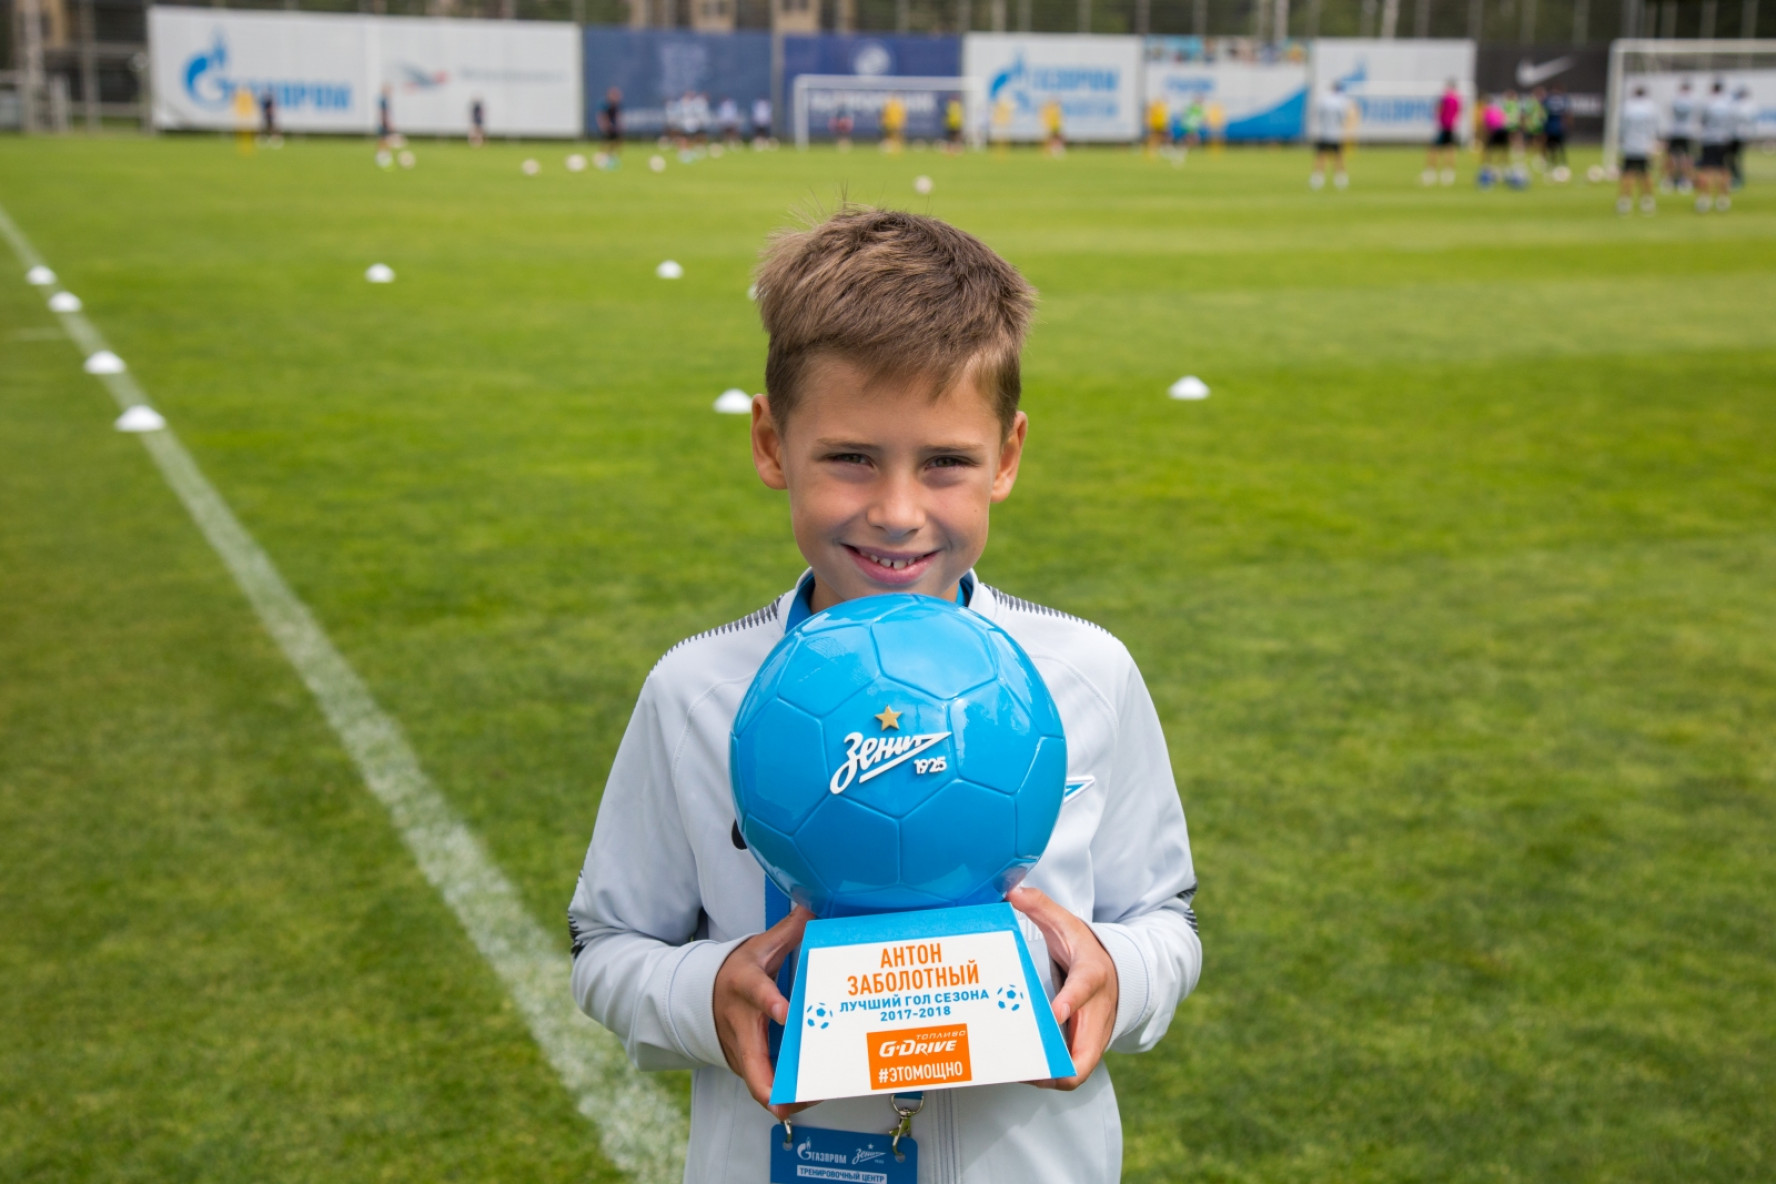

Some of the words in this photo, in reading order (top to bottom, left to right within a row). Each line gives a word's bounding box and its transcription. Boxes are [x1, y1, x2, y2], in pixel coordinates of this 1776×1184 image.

[914, 756, 947, 774] 1925
[880, 943, 942, 968] АНТОН
[847, 960, 979, 996] ЗАБОЛОТНЫЙ
[840, 994, 901, 1012] ЛУЧШИЙ
[905, 994, 931, 1007] ГОЛ
[934, 989, 989, 1004] СЕЗОНА
[880, 1006, 951, 1022] 2017-2018
[916, 1030, 966, 1041] ТОПЛИВО
[878, 1061, 963, 1083] #ЭТОМОЩНО
[811, 1152, 847, 1165] ГАЗПРОМ
[800, 1167, 860, 1180] ТРЕНИРОВОЧНЫЙ
[862, 1174, 885, 1184] ЦЕНТР
